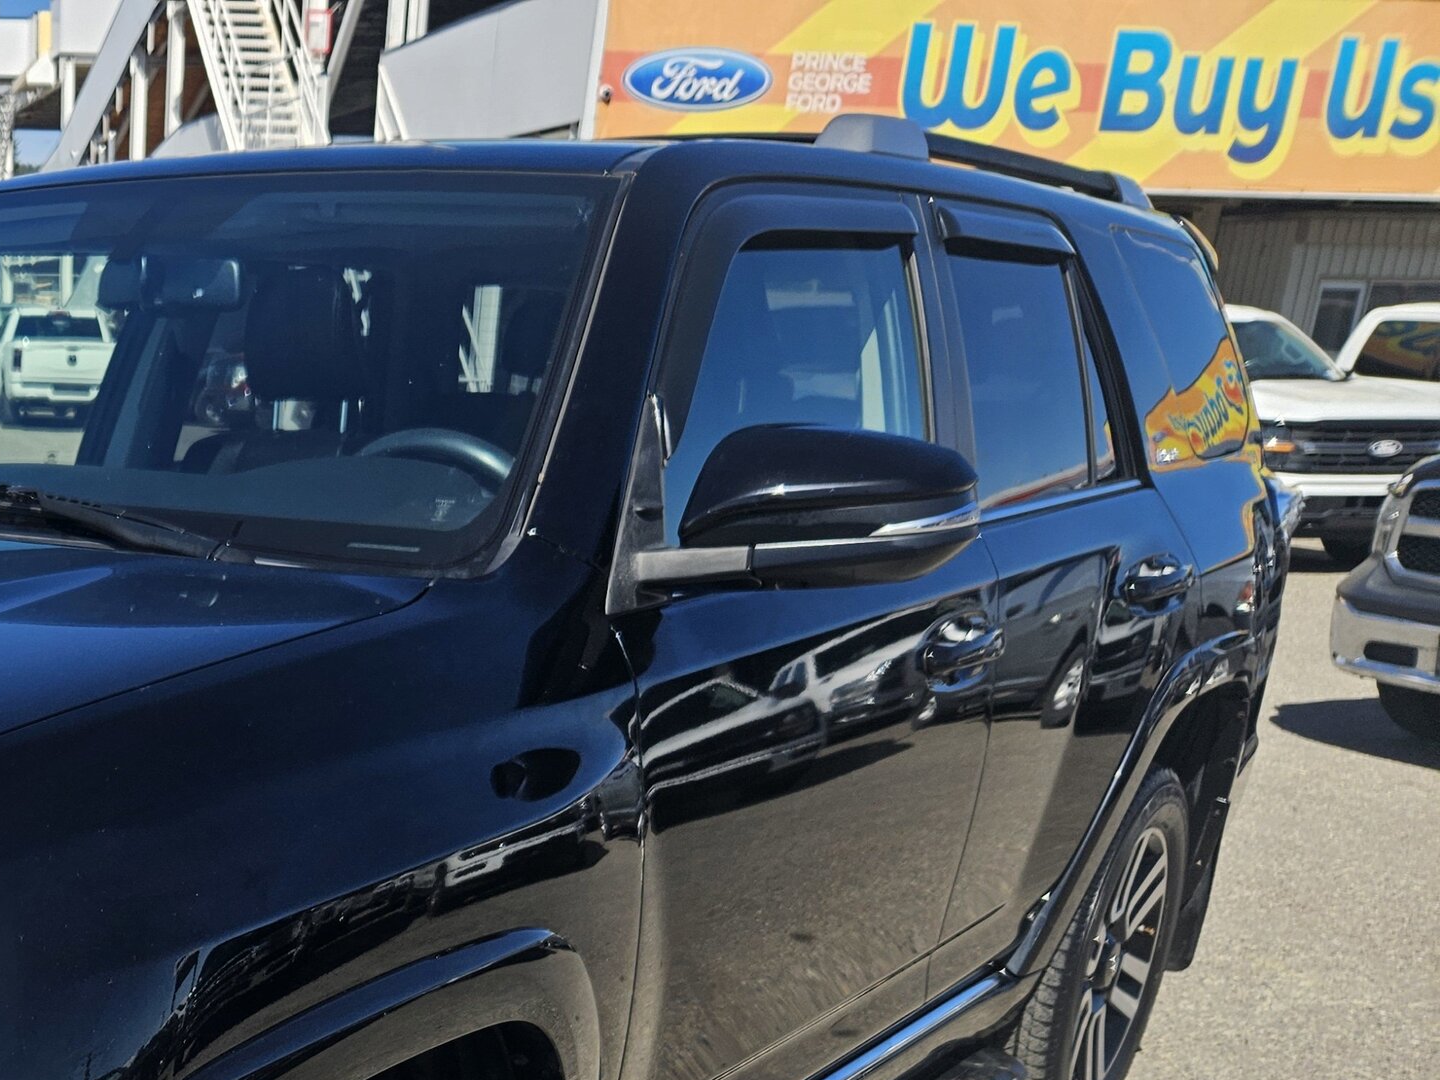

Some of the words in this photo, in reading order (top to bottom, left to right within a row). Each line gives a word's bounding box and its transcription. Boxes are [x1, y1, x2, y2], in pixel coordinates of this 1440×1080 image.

[791, 51, 867, 73] PRINCE
[651, 55, 745, 102] Ford
[788, 72, 873, 95] GEORGE
[785, 93, 843, 113] FORD
[902, 21, 1071, 131] We
[1098, 30, 1299, 164] Buy
[1326, 37, 1440, 141] Us
